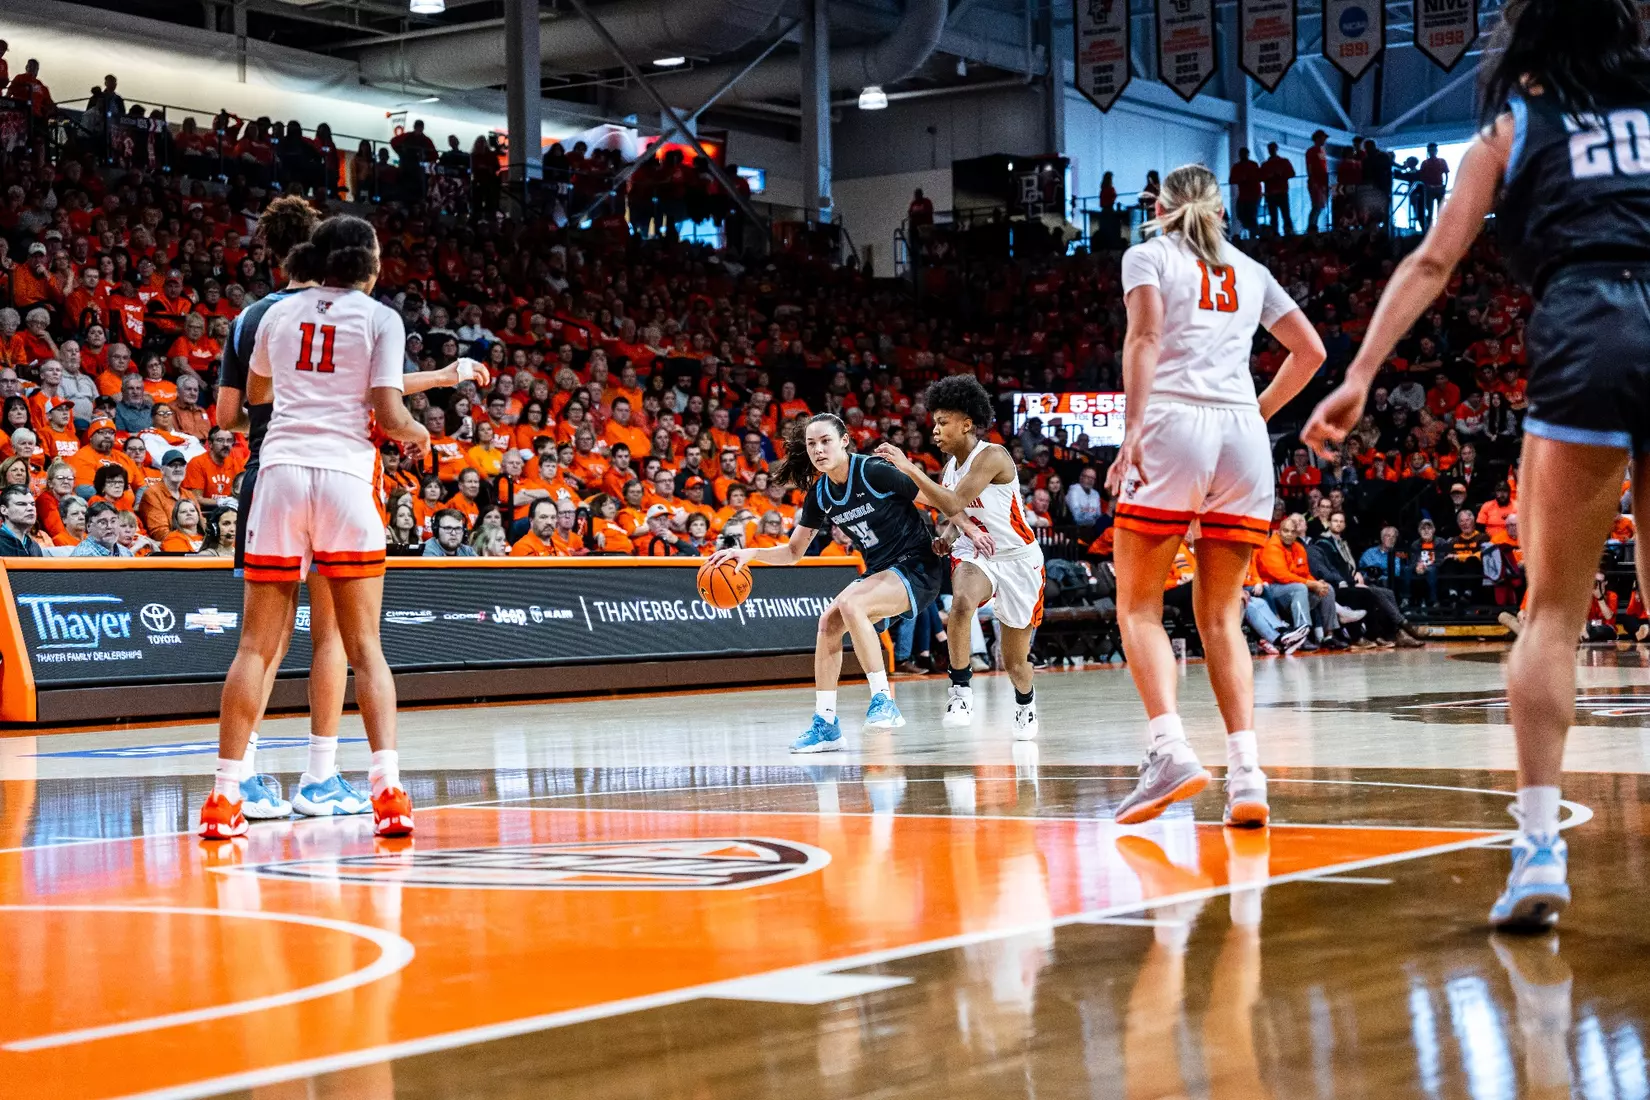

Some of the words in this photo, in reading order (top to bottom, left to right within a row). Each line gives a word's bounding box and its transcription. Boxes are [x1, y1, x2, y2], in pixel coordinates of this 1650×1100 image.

[1424, 0, 1468, 12] NIVC
[1560, 108, 1650, 178] 20
[1196, 259, 1239, 313] 13
[295, 322, 336, 373] 11
[1070, 394, 1127, 413] 5:55
[1094, 414, 1107, 426] 3
[491, 605, 528, 625] Jeep
[543, 609, 574, 619] RAM
[593, 599, 732, 622] THAYERBG.COM
[17, 594, 132, 649] Thayer
[147, 635, 182, 645] TOYOTA
[36, 652, 67, 663] THAYER
[67, 651, 92, 662] FAMILY
[93, 649, 143, 661] DEALERSHIPS
